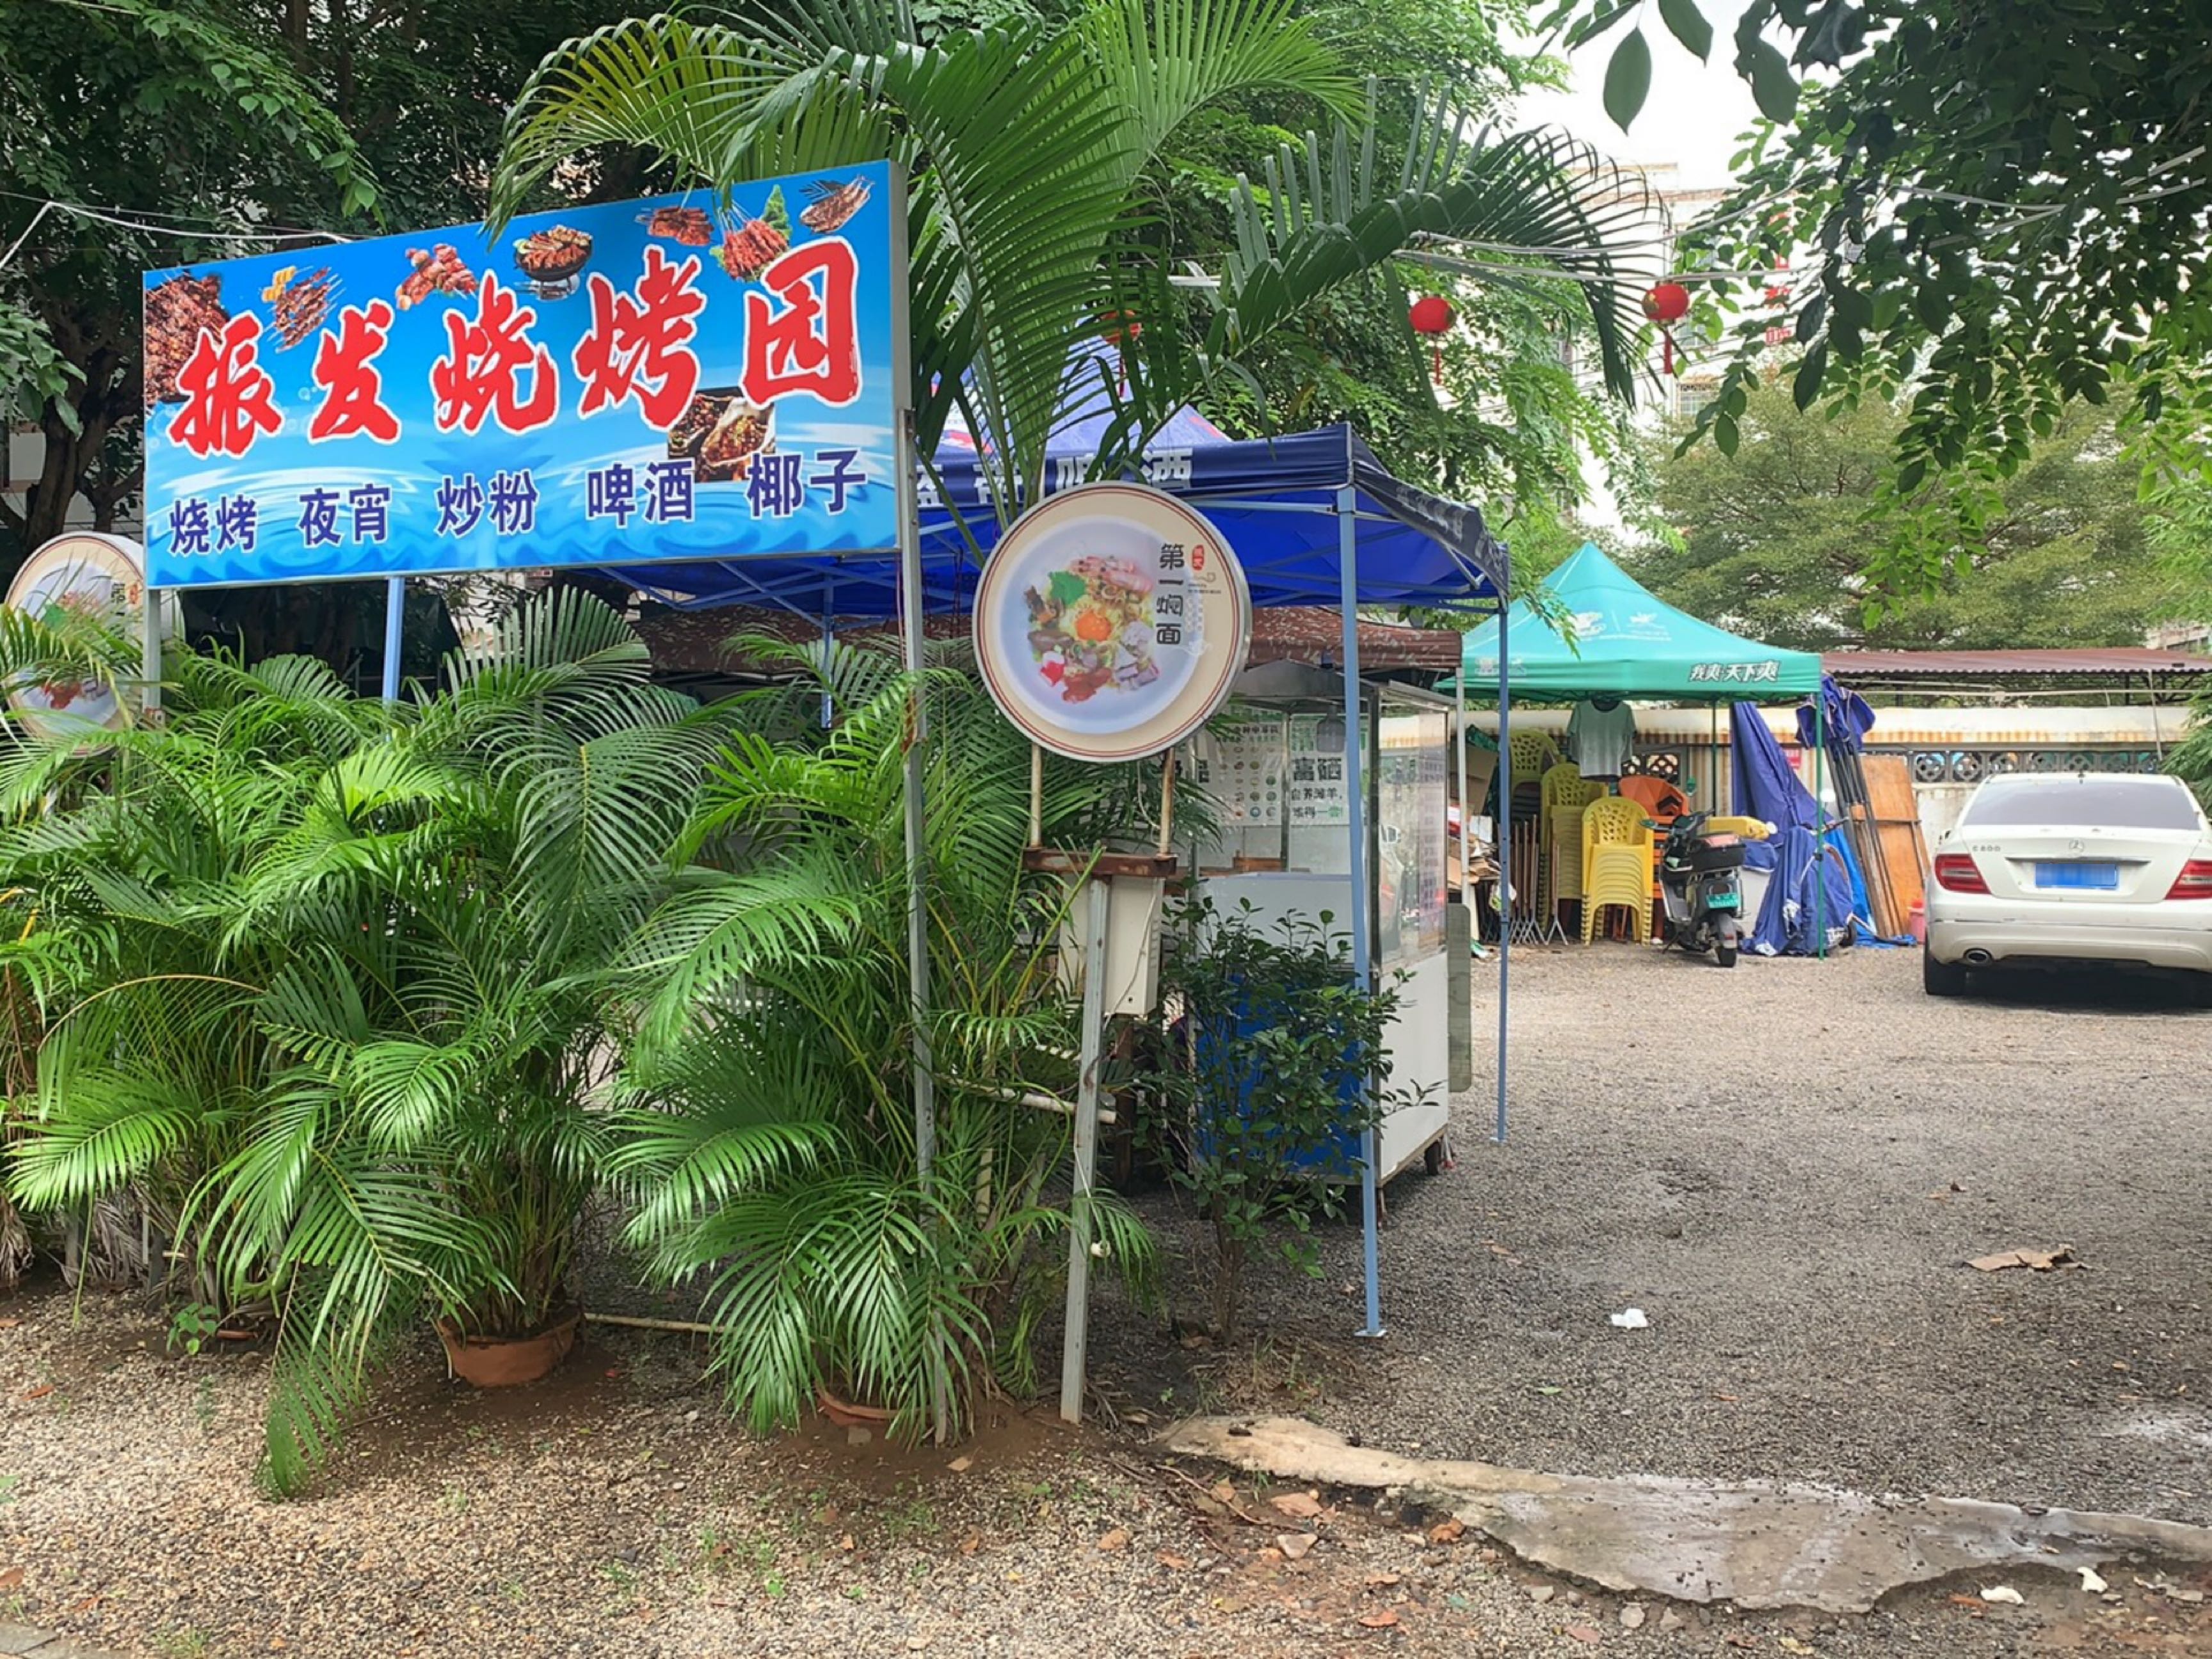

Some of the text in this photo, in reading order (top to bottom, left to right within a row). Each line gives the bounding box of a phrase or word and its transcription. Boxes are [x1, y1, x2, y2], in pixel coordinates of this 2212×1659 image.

[167, 236, 862, 460] 振发烧烤园
[169, 449, 867, 556] 烧烤 夜宵 炒粉 啤酒 椰子
[1156, 542, 1185, 645] 第一焖面
